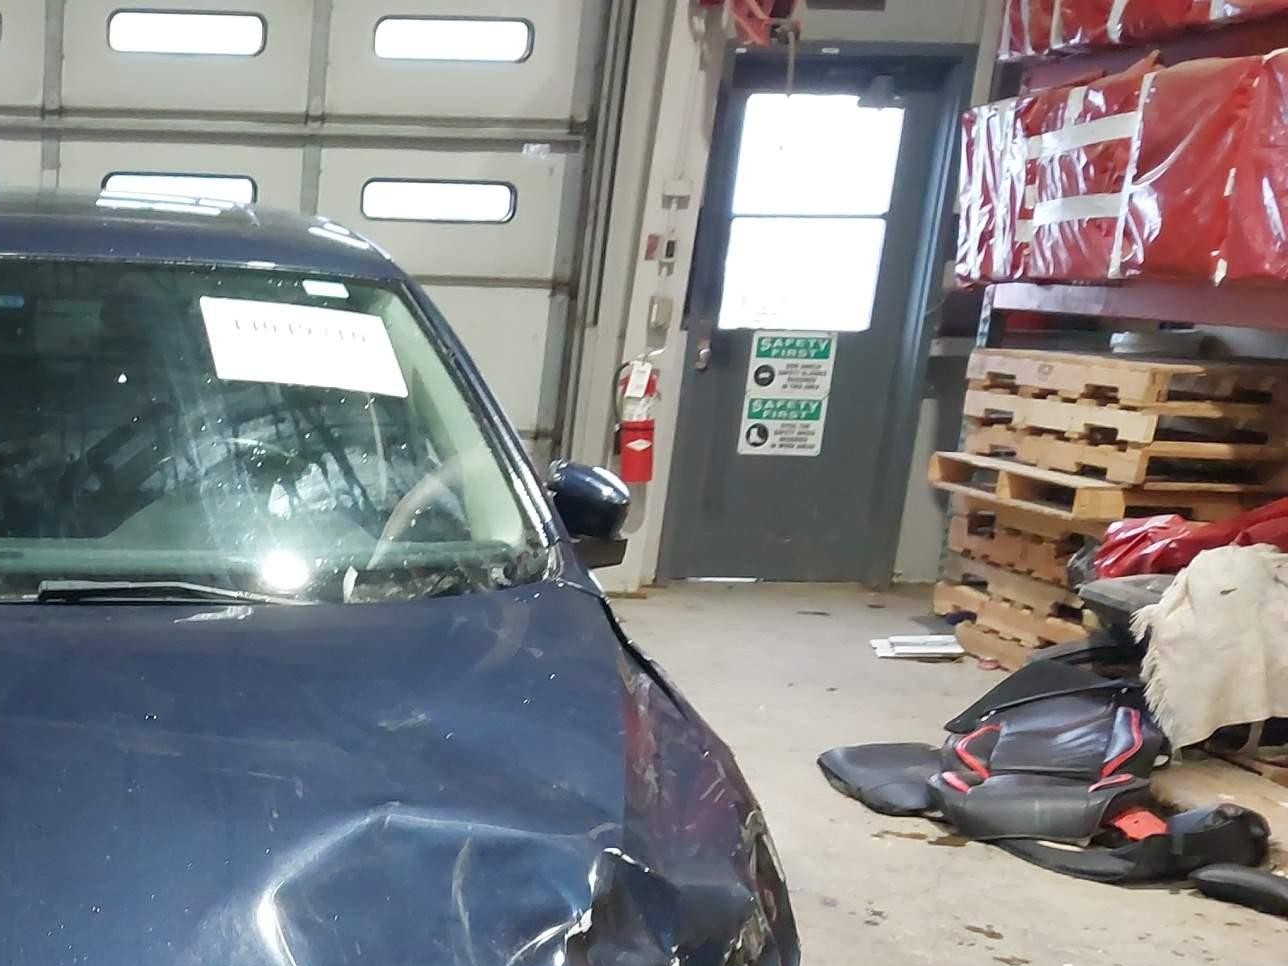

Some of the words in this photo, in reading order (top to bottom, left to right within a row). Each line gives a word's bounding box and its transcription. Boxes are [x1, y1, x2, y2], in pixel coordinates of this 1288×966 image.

[760, 338, 829, 352] SAFETY
[770, 348, 818, 358] FIRST
[751, 399, 819, 413] SAFETY
[761, 410, 808, 419] FIRST
